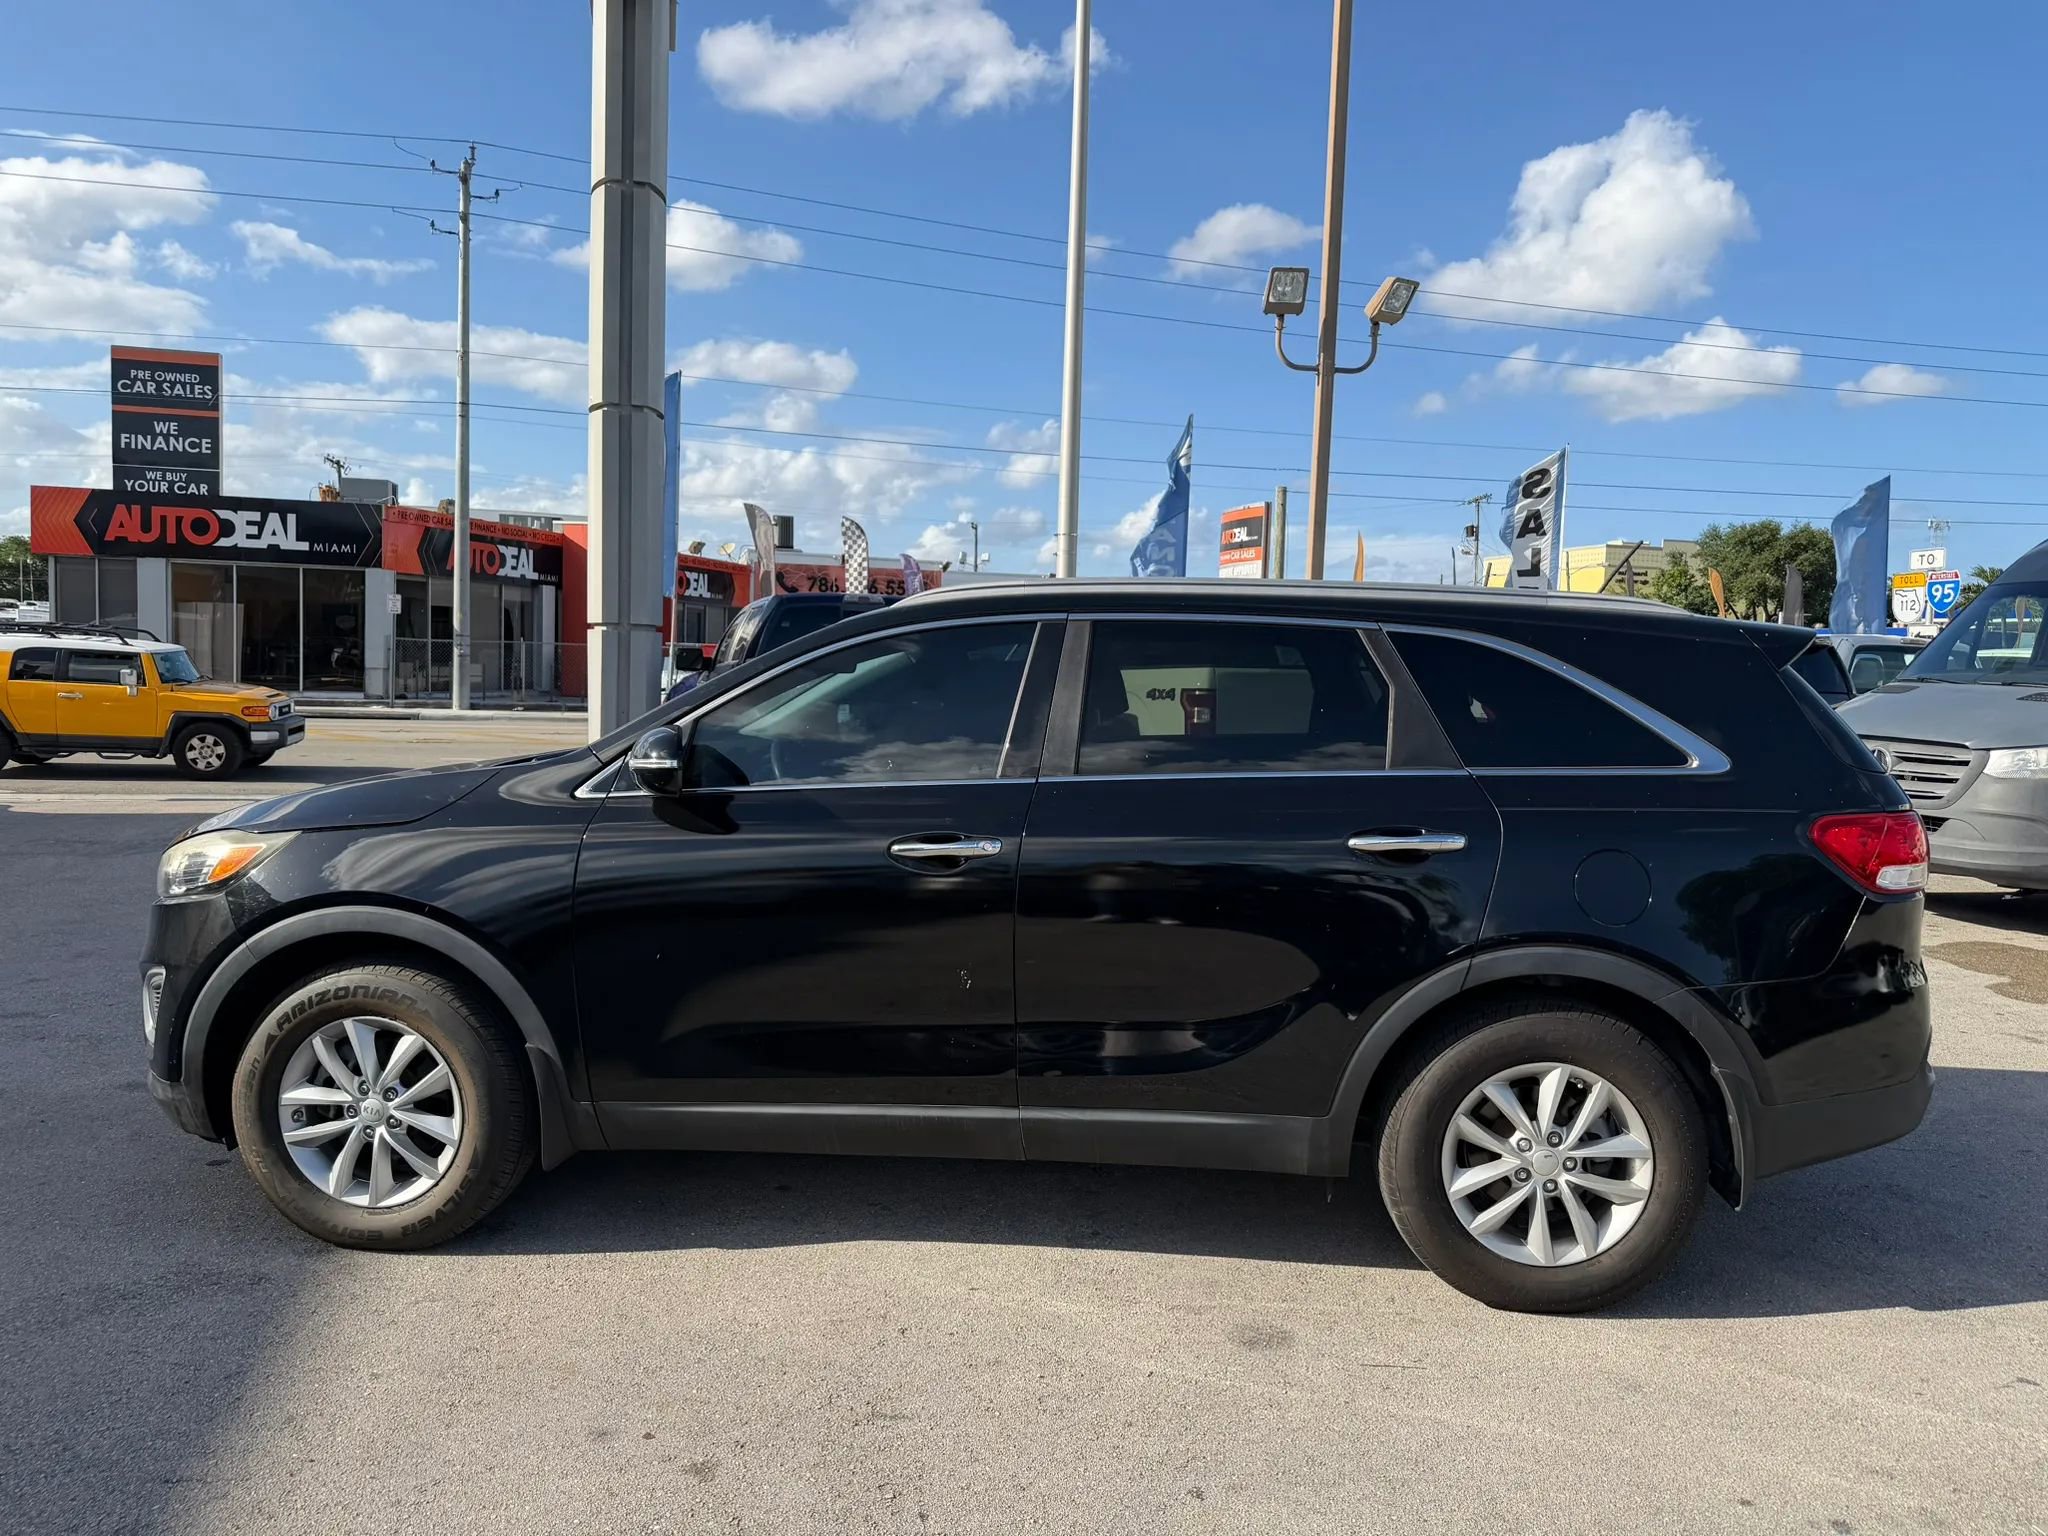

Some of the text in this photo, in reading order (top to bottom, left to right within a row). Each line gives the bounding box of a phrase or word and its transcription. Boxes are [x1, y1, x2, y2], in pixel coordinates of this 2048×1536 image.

[130, 369, 200, 383] PRE OWNED
[117, 379, 213, 399] CAR SALES
[153, 421, 179, 435] WE
[120, 433, 212, 454] FINANCE
[145, 470, 188, 482] WE BUY
[124, 480, 209, 496] YOUR CAR
[313, 543, 357, 554] MIAMI
[1919, 553, 1935, 565] TO
[1900, 576, 1919, 584] TOLL
[1931, 583, 1955, 603] 95
[1900, 600, 1916, 611] 112
[363, 1105, 381, 1116] KIA
